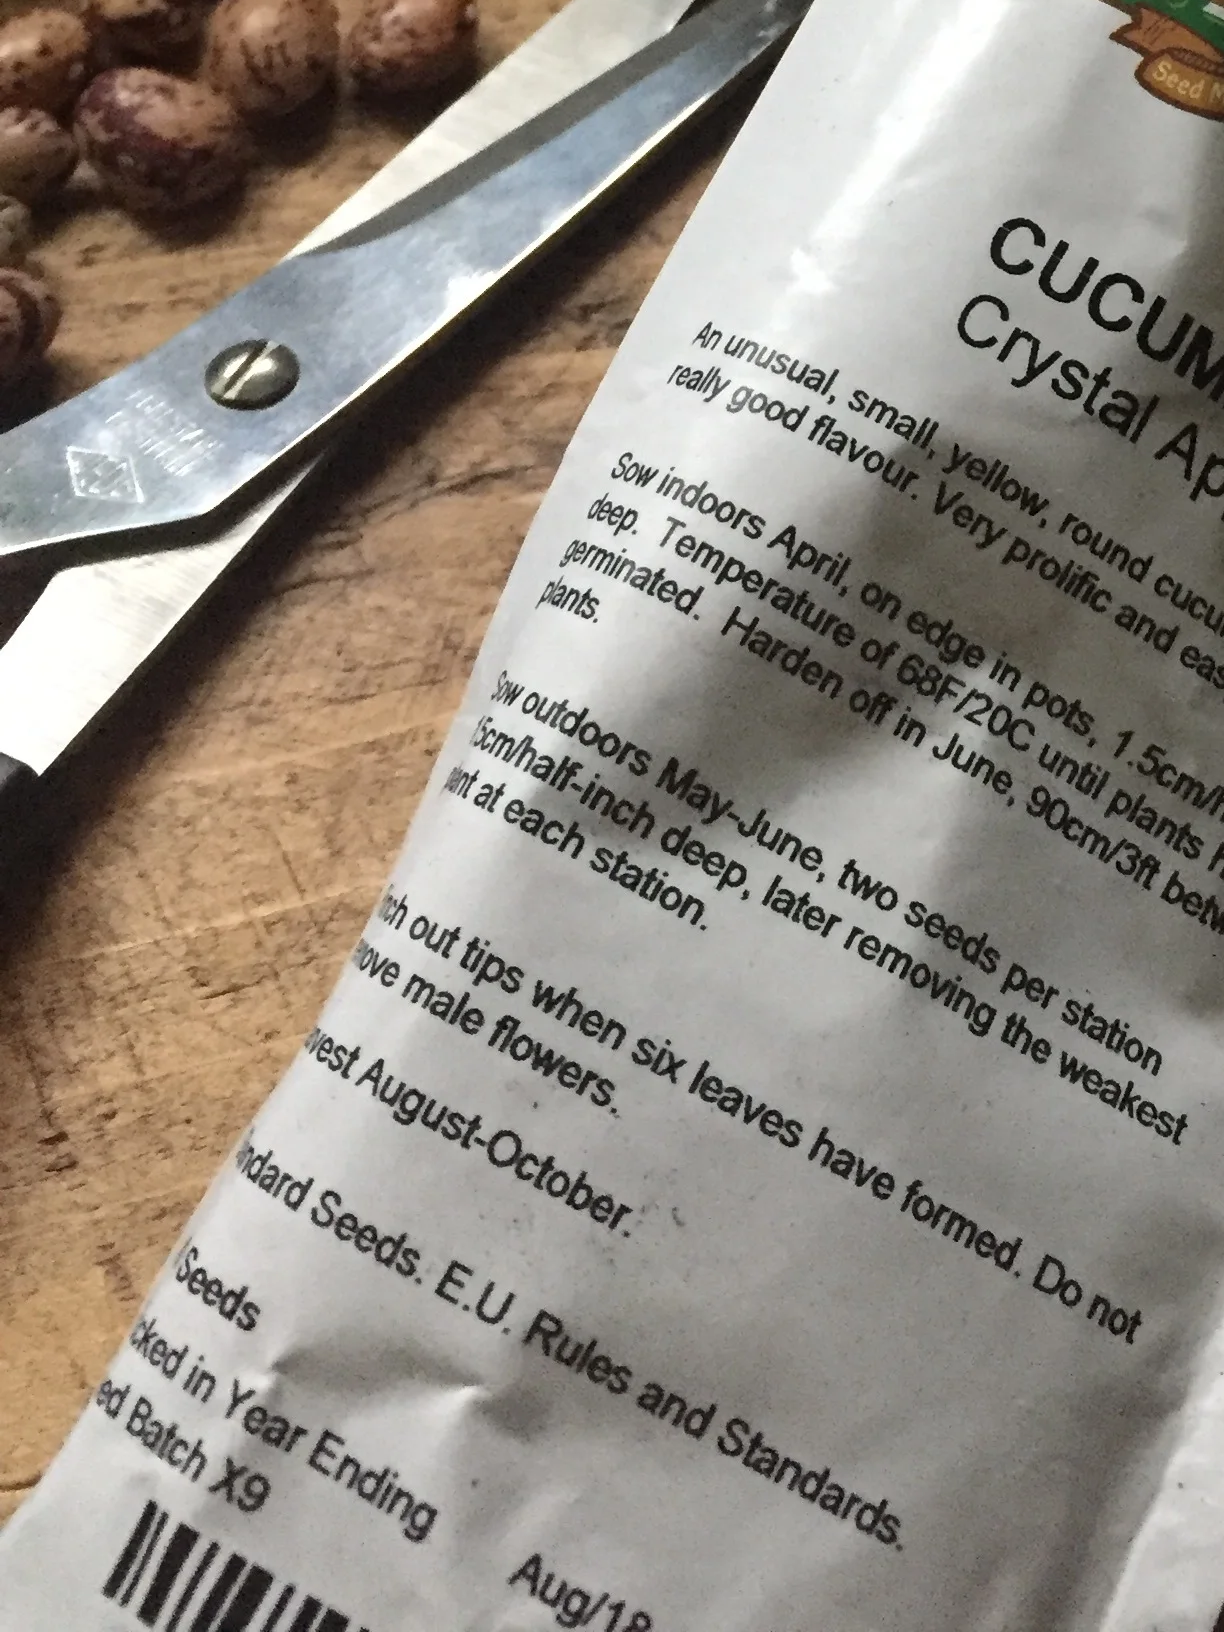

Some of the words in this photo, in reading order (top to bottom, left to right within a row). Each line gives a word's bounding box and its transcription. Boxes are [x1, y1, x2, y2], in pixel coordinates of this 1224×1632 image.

[1153, 61, 1205, 99] Seed
[691, 321, 722, 351] An
[724, 334, 839, 405] unusual,
[848, 389, 939, 460] small,
[941, 443, 1050, 528] yellow,
[1059, 513, 1154, 583] round
[957, 294, 1159, 443] Crystal
[536, 575, 602, 624] plants.
[611, 452, 659, 486] Sow
[656, 467, 766, 540] indoors
[767, 525, 852, 597] April,
[860, 581, 901, 620] on
[906, 608, 986, 670] edge
[989, 651, 1022, 692] in
[1022, 681, 1096, 749] pots,
[666, 363, 731, 403] really
[726, 385, 810, 432] good
[808, 414, 919, 500] flavour.
[933, 481, 1007, 549] Very
[1001, 537, 1112, 613] prolific
[1114, 605, 1180, 653] and
[559, 536, 705, 621] germinated.
[720, 606, 843, 700] Harden
[849, 687, 898, 726] off
[895, 707, 927, 748] in
[932, 733, 1015, 807] June,
[1026, 785, 1161, 891] 90cm/3ft
[587, 492, 639, 536] deep.
[659, 516, 856, 648] Temperature
[860, 634, 900, 670] of
[896, 653, 1036, 753] 68F/20C
[1038, 742, 1110, 800] until
[1104, 789, 1204, 860] plants
[473, 783, 506, 813] at
[503, 800, 586, 858] each
[590, 846, 707, 931] station.
[491, 670, 525, 706] Sow
[522, 692, 652, 776] outdoors
[655, 757, 825, 883] May-June,
[837, 859, 899, 913] two
[904, 898, 1001, 974] seeds
[1000, 962, 1059, 1011] per
[1060, 994, 1163, 1077] station
[659, 825, 750, 900] deep,
[761, 875, 842, 939] later
[844, 923, 997, 1037] removing
[1001, 1013, 1052, 1065] the
[1059, 1050, 1188, 1146] weakest
[355, 1058, 630, 1237] August-October.
[401, 973, 485, 1035] male
[488, 1014, 618, 1115] flowers.
[409, 914, 461, 959] out
[460, 936, 525, 994] tips
[532, 979, 627, 1051] when
[632, 1039, 687, 1084] six
[688, 1061, 803, 1148] leaves
[807, 1127, 895, 1200] have
[900, 1179, 1023, 1277] formed.
[1033, 1254, 1082, 1307] Do
[1090, 1291, 1143, 1344] not
[126, 1396, 207, 1482] Batch
[208, 1456, 271, 1512] X9
[130, 1316, 189, 1380] cked
[182, 1354, 216, 1403] in
[225, 1378, 305, 1453] Year
[307, 1429, 437, 1543] Ending
[310, 1190, 423, 1285] Seeds.
[435, 1259, 516, 1335] E.U.
[523, 1308, 633, 1395] Rules
[637, 1382, 719, 1441] and
[717, 1418, 904, 1552] Standards.
